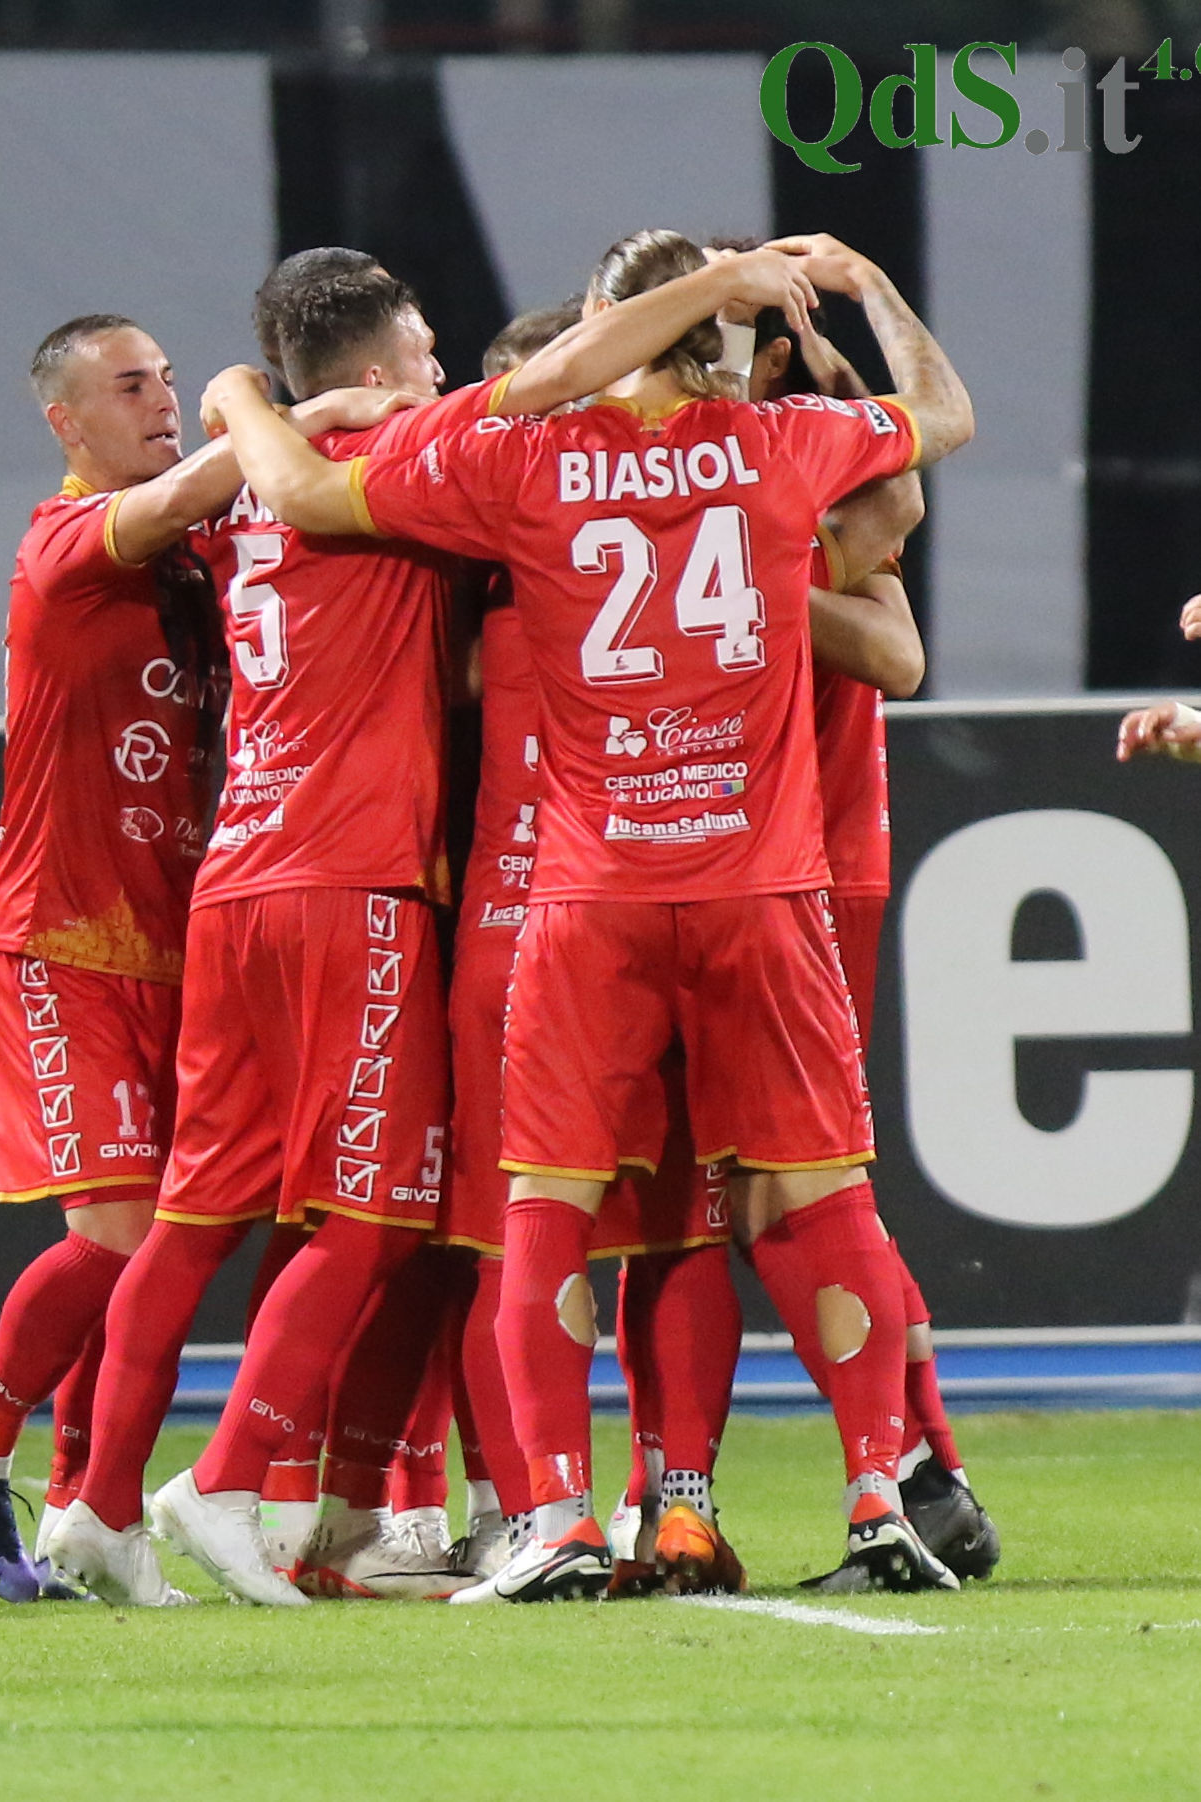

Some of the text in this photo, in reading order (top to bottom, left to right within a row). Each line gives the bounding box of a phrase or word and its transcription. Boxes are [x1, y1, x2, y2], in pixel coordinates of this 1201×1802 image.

[560, 435, 760, 502] BIASIOL
[229, 533, 289, 691] 5
[571, 504, 766, 686] 24
[605, 761, 749, 791] CENTRO MEDICO
[635, 782, 710, 805] LUCANO
[900, 808, 1196, 1230] e
[421, 1125, 445, 1188] 5
